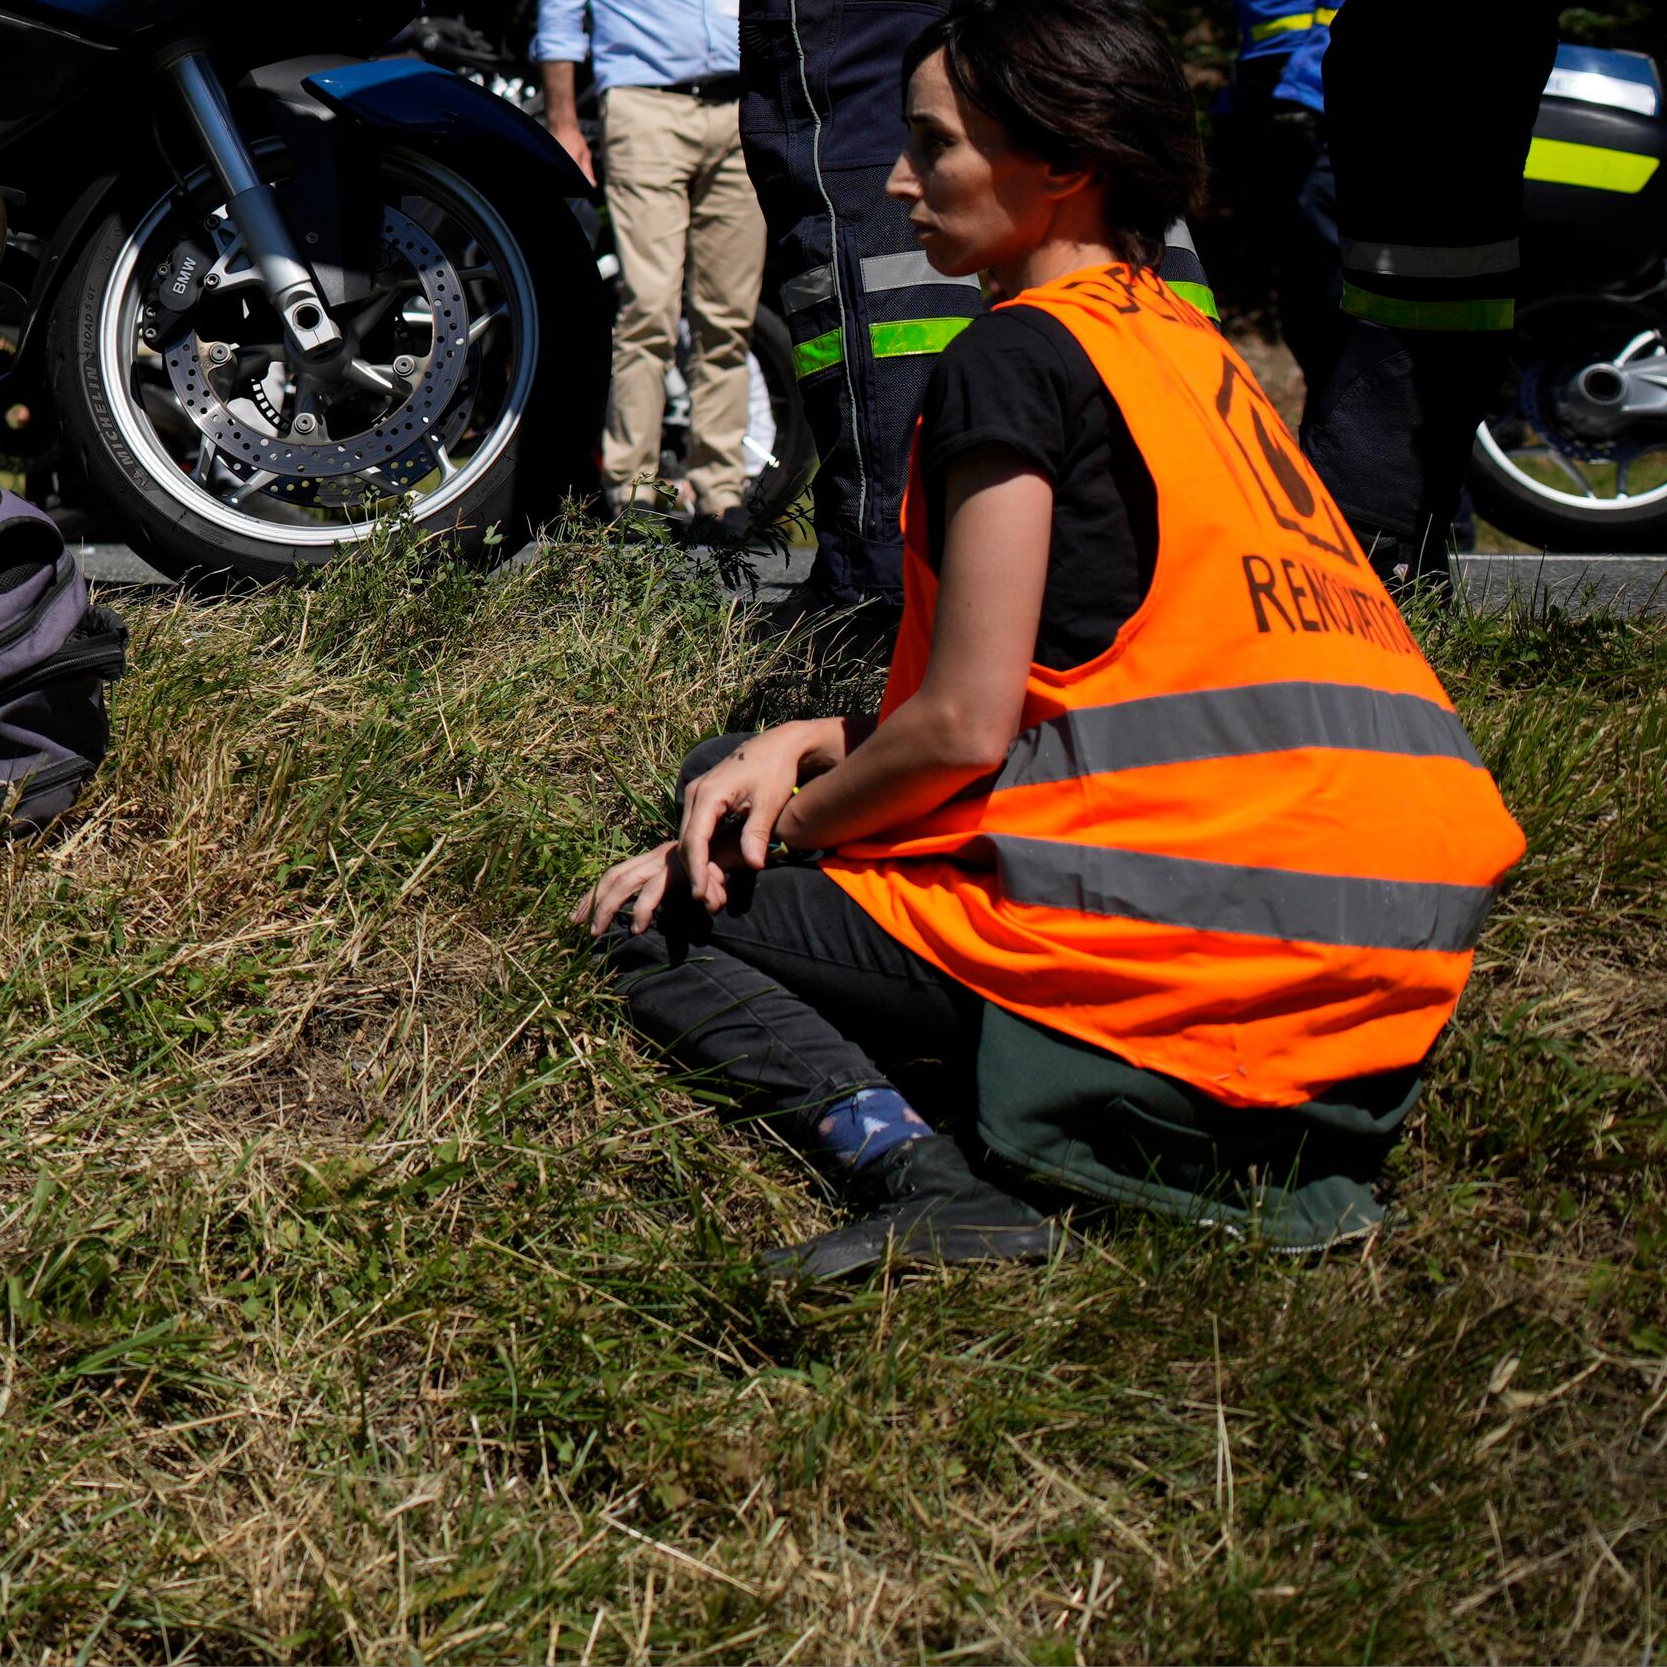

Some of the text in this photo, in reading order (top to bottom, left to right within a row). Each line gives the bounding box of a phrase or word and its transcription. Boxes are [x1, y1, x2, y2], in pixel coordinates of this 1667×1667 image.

[172, 256, 197, 295] BMW
[83, 313, 93, 349] ROAD
[85, 365, 134, 467] MICHELIN
